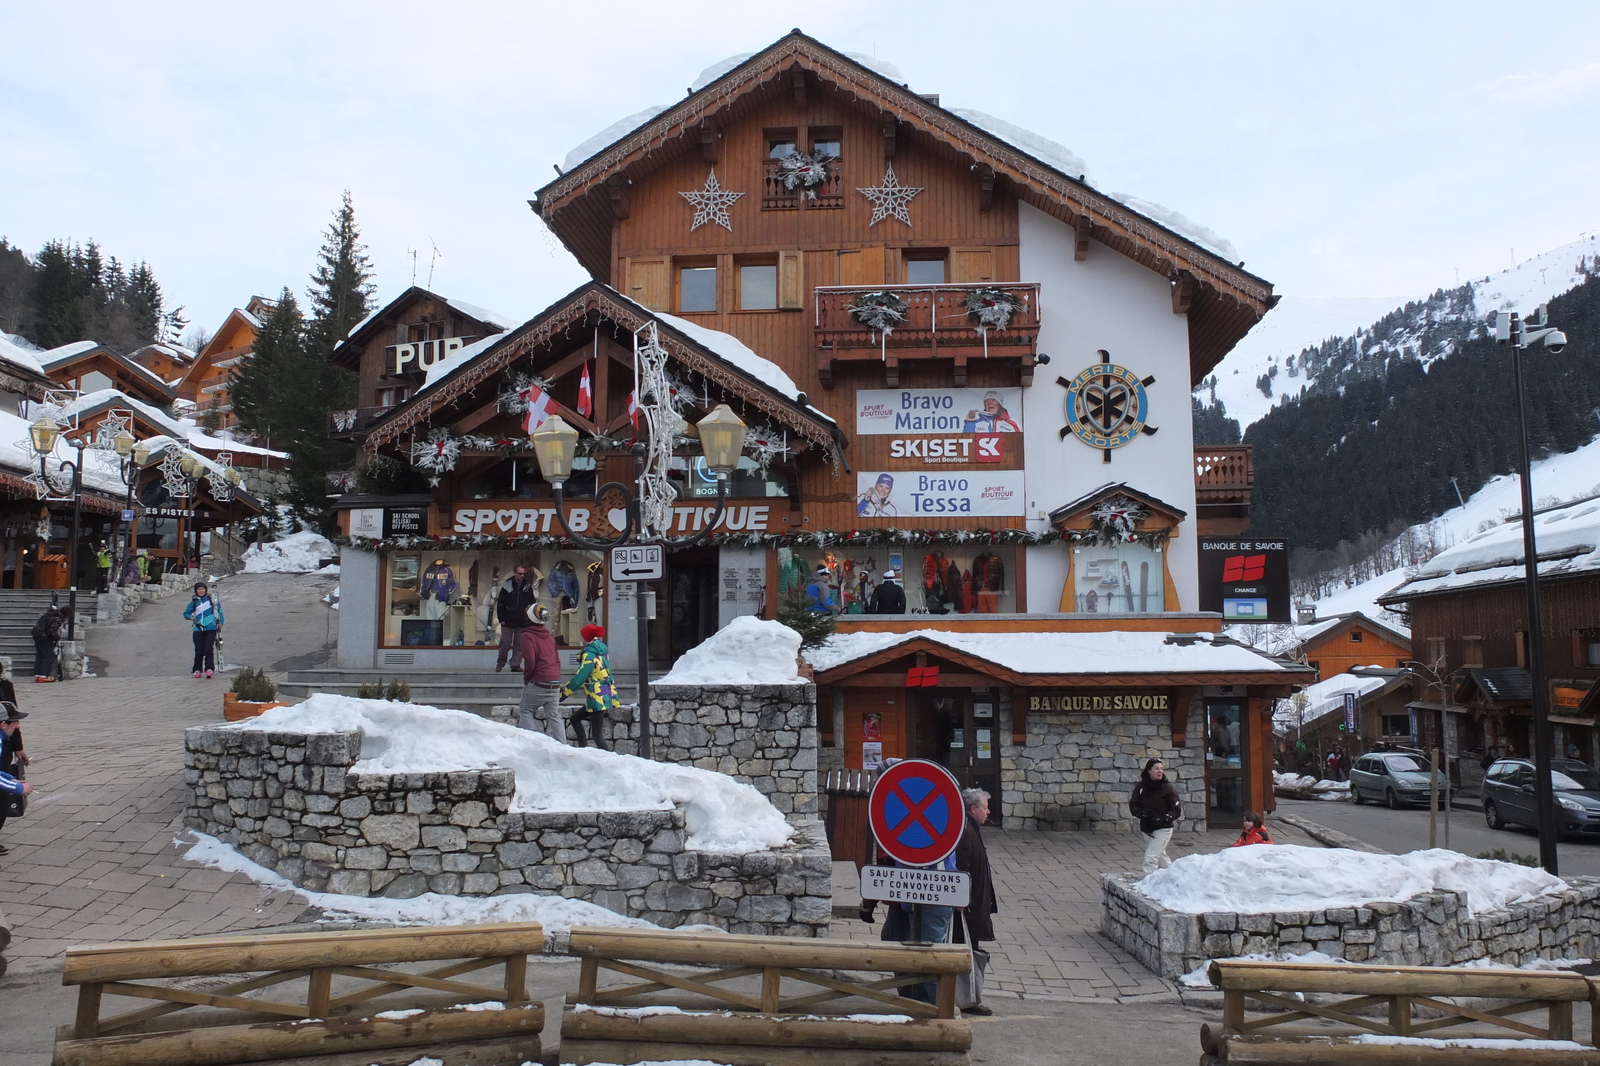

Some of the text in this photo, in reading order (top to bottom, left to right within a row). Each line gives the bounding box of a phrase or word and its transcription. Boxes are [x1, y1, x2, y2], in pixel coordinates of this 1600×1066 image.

[1069, 365, 1142, 393] MERIBEL
[901, 392, 953, 410] Bravo
[860, 409, 893, 417] BOUTIQUE
[895, 411, 960, 430] Marion
[1071, 421, 1143, 447] SPORTS
[890, 438, 973, 458] SKISET
[919, 475, 969, 491] Bravo
[910, 493, 971, 513] Tessa
[160, 508, 195, 517] PISTES
[453, 508, 558, 533] SPORT
[1202, 542, 1284, 550] BANQUE DE SAVOIE
[1030, 695, 1168, 711] BANQUE DE SAVOIE
[869, 869, 961, 883] SAUF LIVRAISONS
[873, 879, 957, 893] ET CONVOYEURS
[889, 890, 940, 902] DE FONDS
